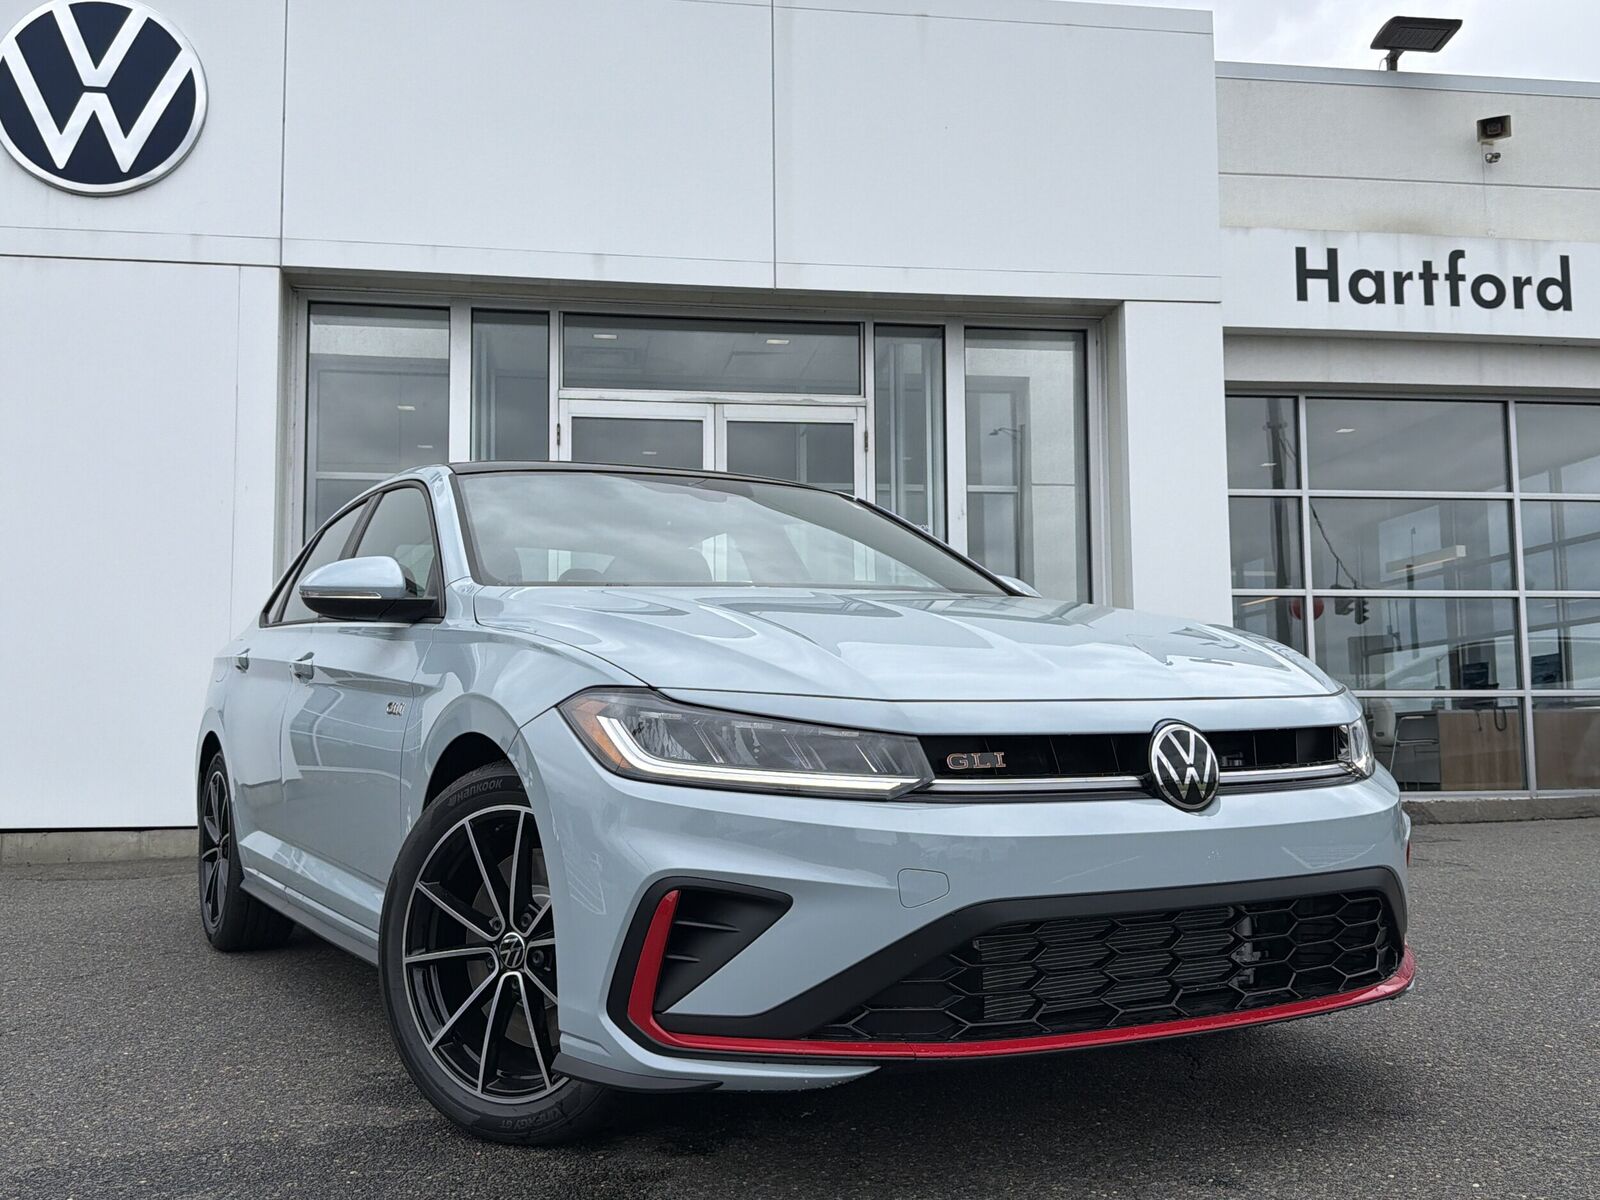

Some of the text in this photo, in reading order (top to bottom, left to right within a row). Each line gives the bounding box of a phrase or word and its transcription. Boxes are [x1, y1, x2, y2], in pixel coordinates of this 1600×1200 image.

[1, 2, 193, 174] VW
[1295, 246, 1573, 311] Hartford
[946, 752, 1006, 769] GLI
[1155, 729, 1213, 801] VW
